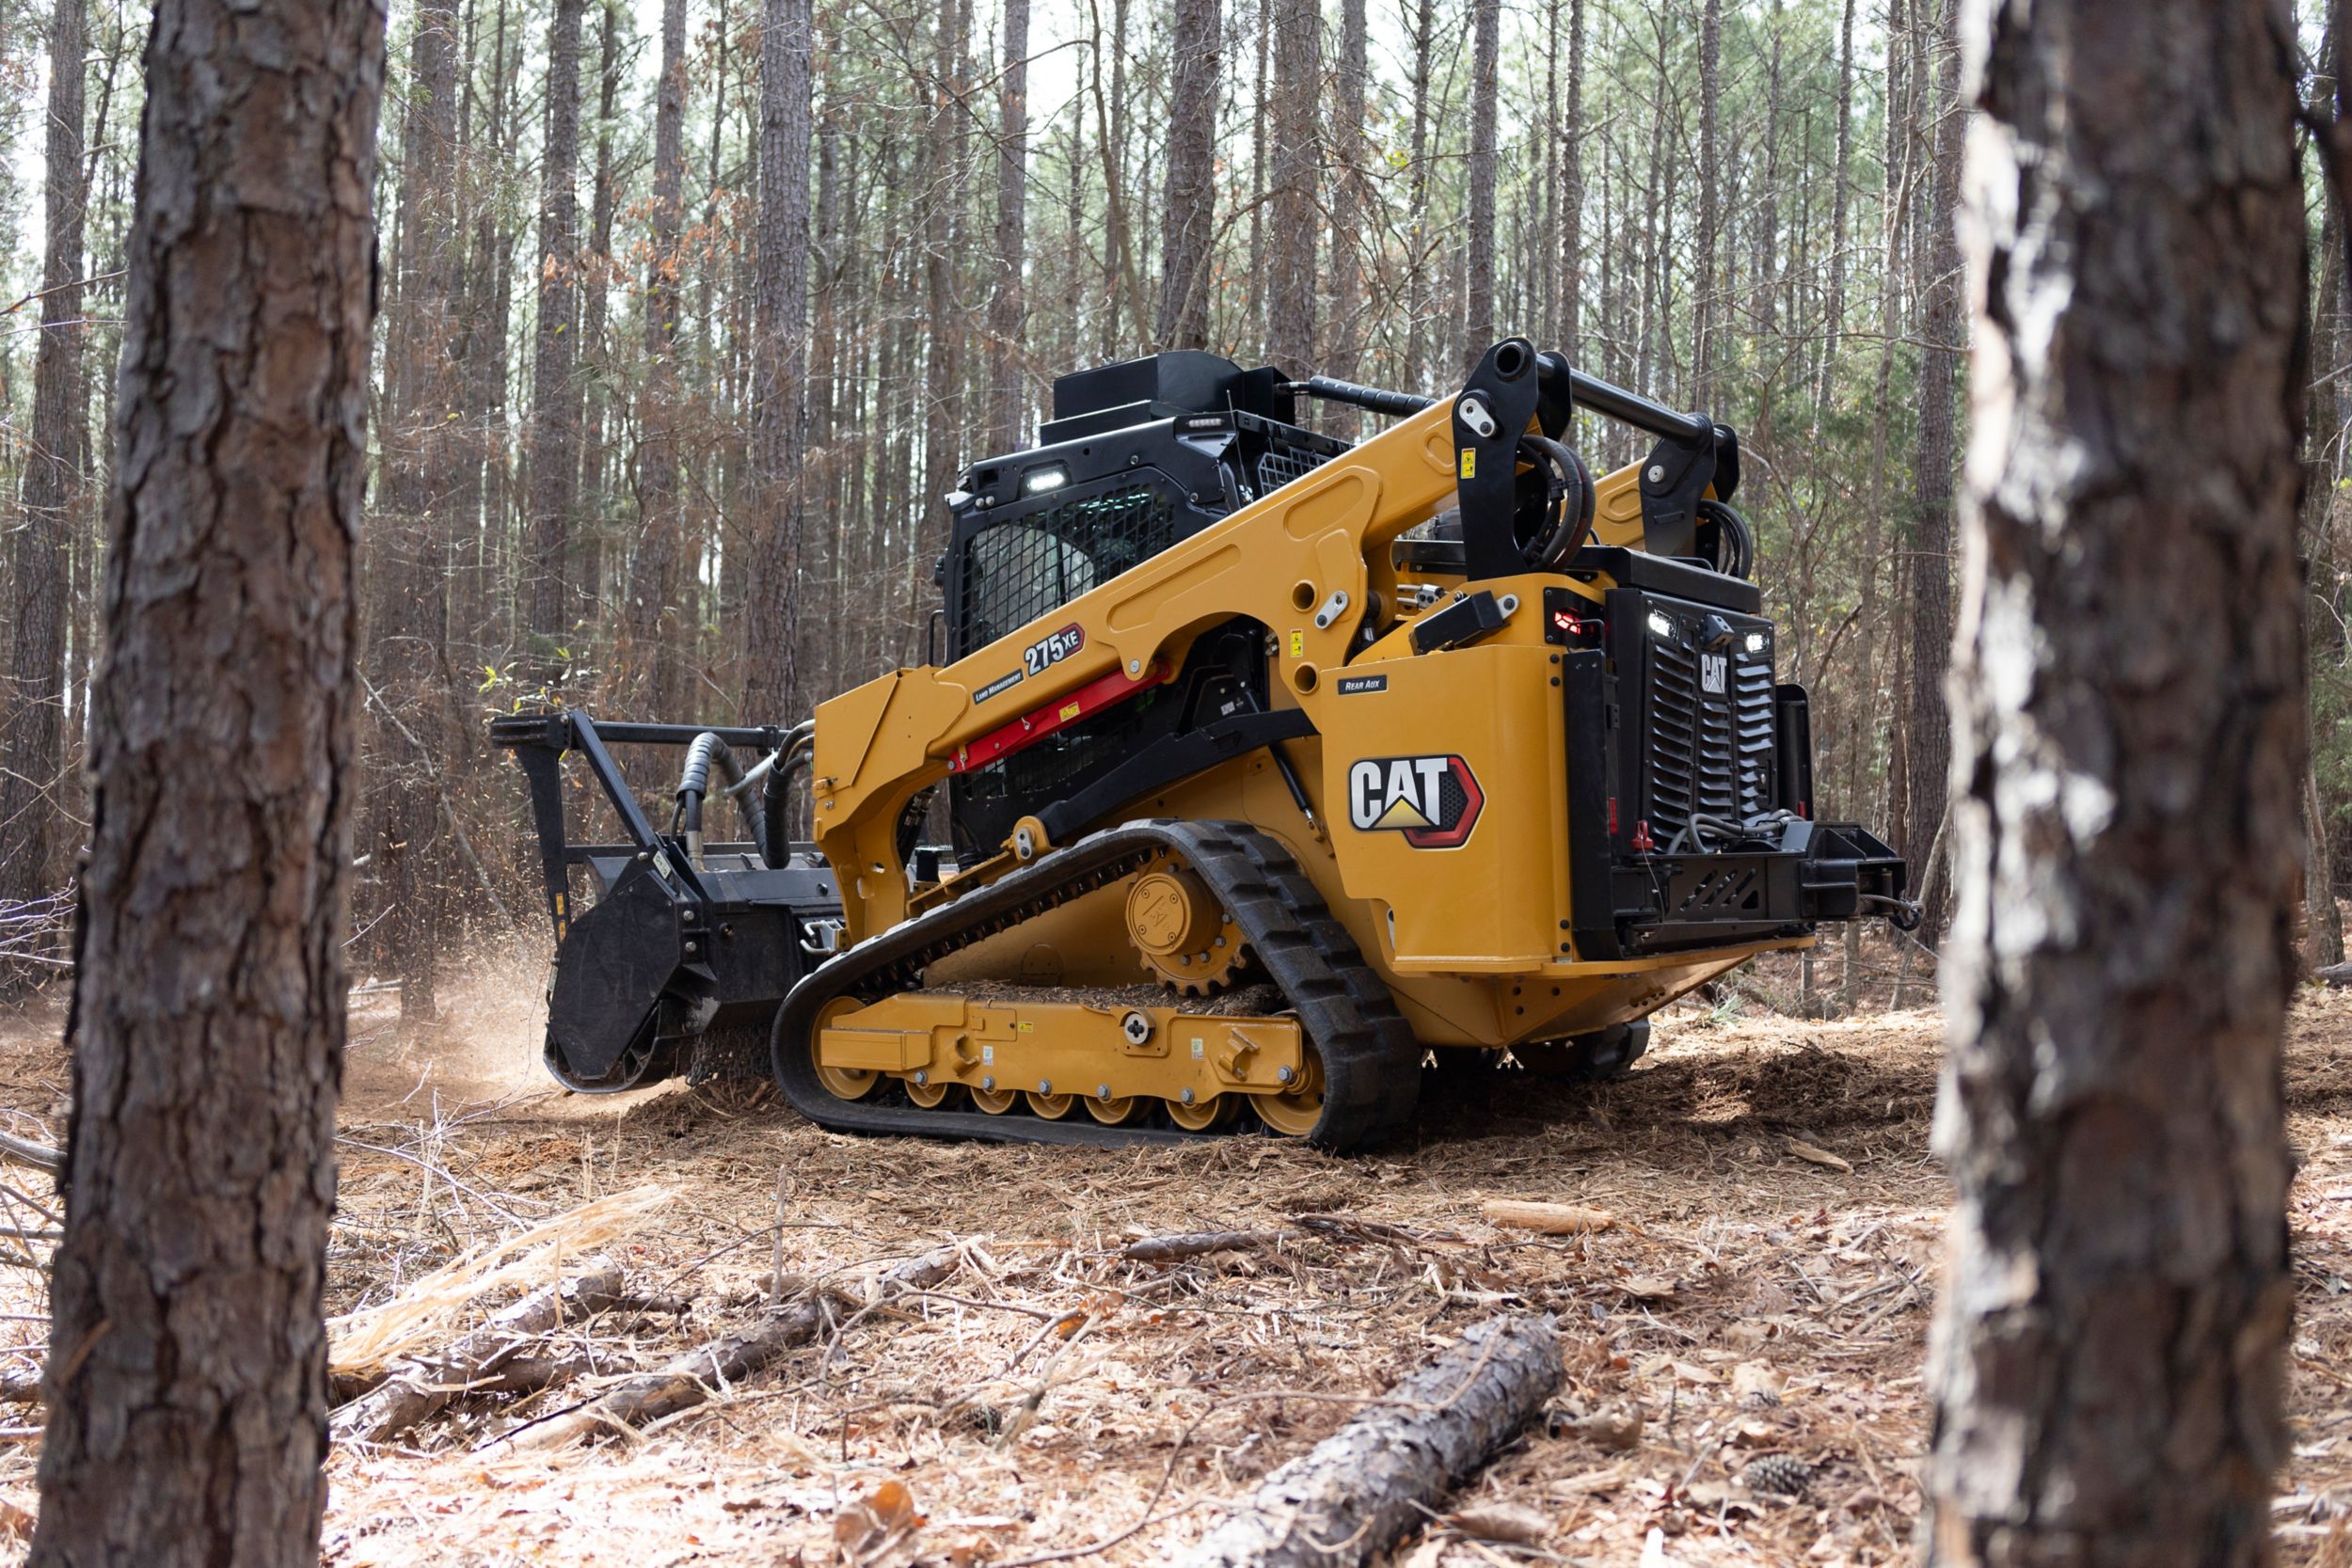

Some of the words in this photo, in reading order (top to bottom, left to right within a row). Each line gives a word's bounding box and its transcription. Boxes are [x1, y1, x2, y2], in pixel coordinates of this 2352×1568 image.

[1025, 630, 1079, 675] 275XE
[1701, 654, 1727, 693] CAT
[1345, 681, 1364, 691] REAR
[1364, 679, 1380, 689] AUX
[1350, 757, 1448, 829] CAT
